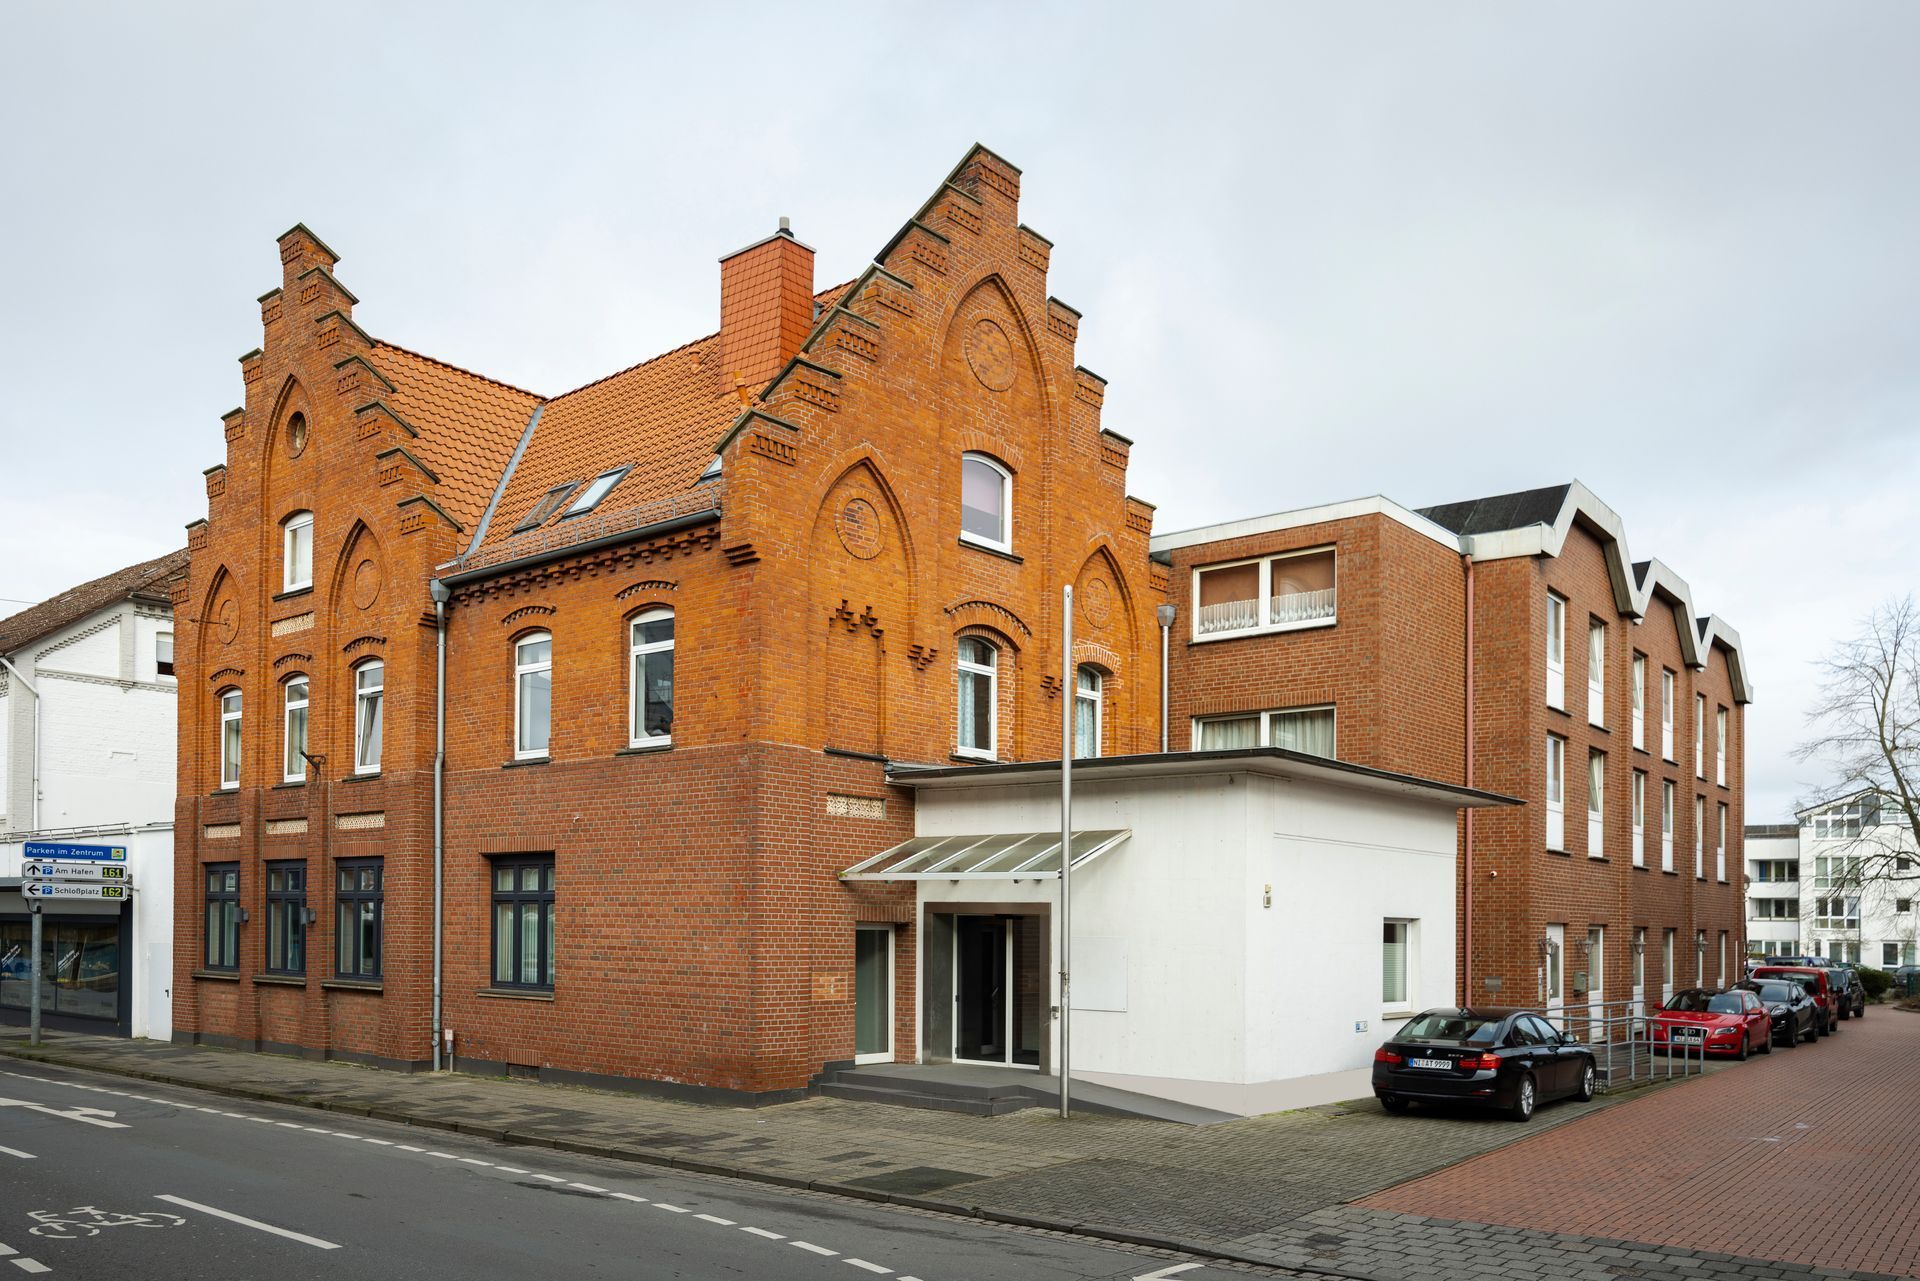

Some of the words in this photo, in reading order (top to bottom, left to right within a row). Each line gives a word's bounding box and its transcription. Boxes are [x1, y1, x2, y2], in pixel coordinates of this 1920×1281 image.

[26, 846, 55, 855] Parken
[70, 848, 104, 857] Zentrum
[54, 867, 69, 875] Am
[71, 868, 94, 876] Hafen
[102, 868, 121, 878] 161
[54, 886, 100, 896] Schloßplatz
[102, 887, 121, 897] 162
